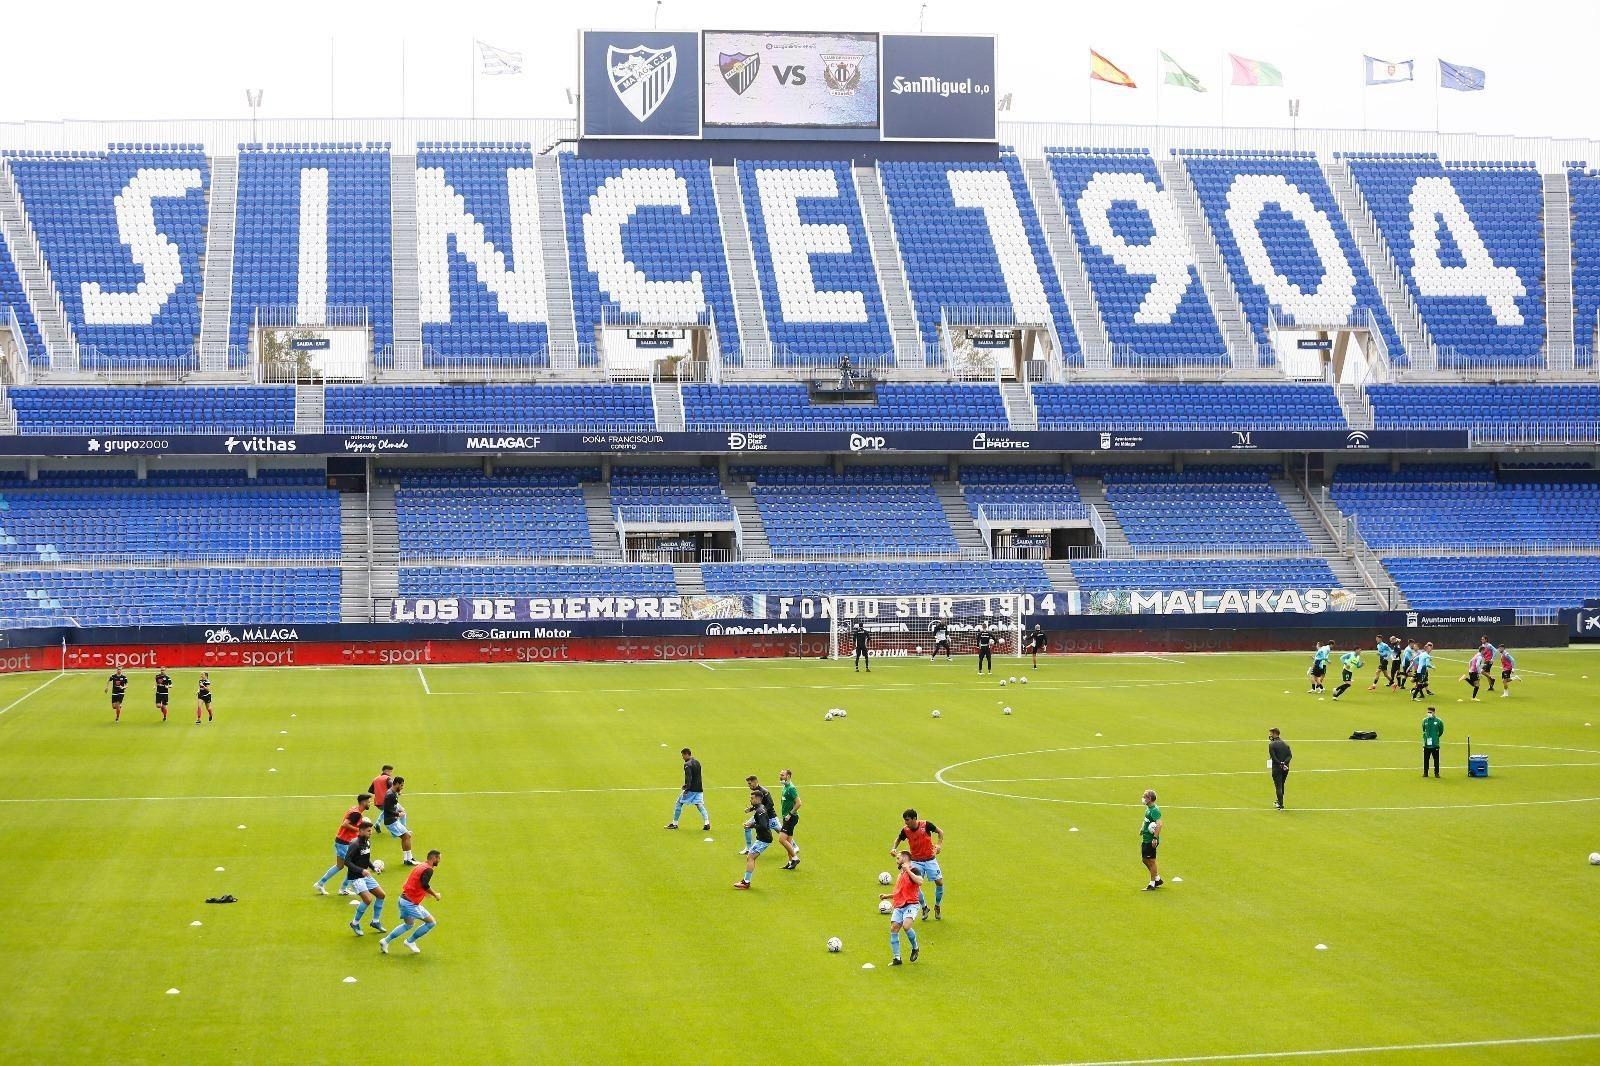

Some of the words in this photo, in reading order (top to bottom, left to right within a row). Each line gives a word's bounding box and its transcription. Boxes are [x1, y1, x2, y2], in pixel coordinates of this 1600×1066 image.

[772, 65, 807, 86] VS
[81, 167, 869, 325] SINCE
[947, 170, 1527, 327] 1904
[105, 440, 169, 452] grupo2000
[242, 437, 297, 452] vithas
[466, 437, 541, 449] MALAGACF
[582, 434, 606, 444] DOÑA
[608, 435, 664, 444] FRANCISQUITA
[393, 598, 459, 621] LOS
[473, 599, 516, 621] DE
[529, 597, 682, 620] SIEMPRE
[895, 597, 954, 618] SUR
[983, 593, 1057, 617] 1904
[1130, 588, 1328, 615] MALAKAS
[1421, 616, 1467, 624] Ayuntamiento
[242, 627, 299, 641] MÁLAGA
[490, 629, 531, 639] Garum
[534, 628, 572, 639] Motor
[105, 647, 158, 669] sport
[242, 648, 295, 666] sport
[379, 644, 432, 666] sport
[516, 644, 569, 664] sport
[653, 641, 705, 661] sport
